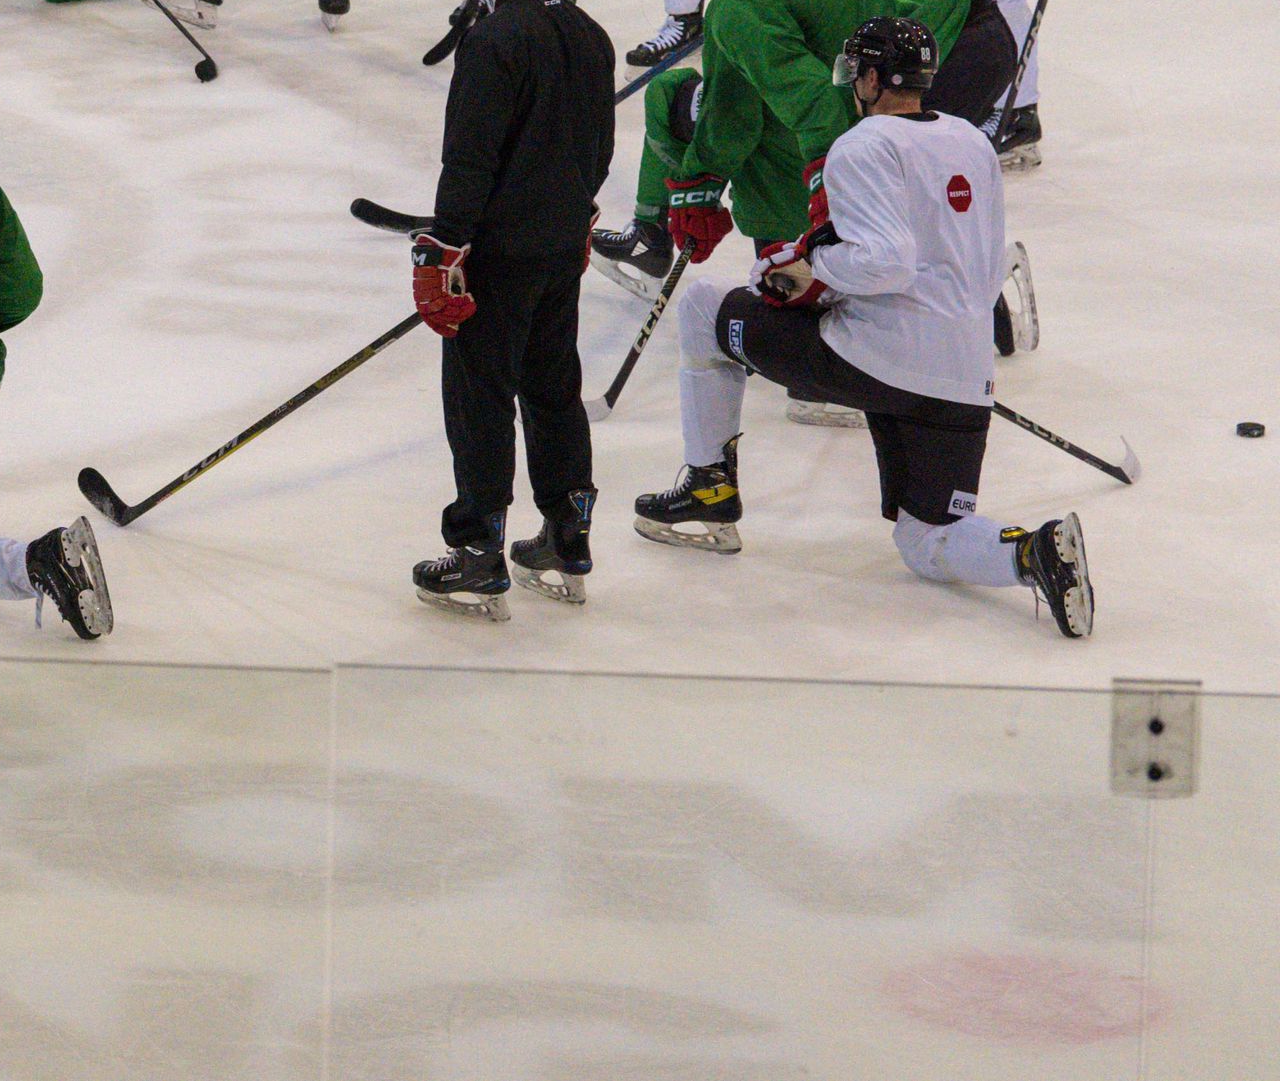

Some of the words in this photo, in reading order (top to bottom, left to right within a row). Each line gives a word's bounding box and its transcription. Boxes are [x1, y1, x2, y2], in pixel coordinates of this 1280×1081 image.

[920, 47, 931, 61] 88
[670, 190, 722, 206] CCM
[949, 189, 970, 198] RESPECT
